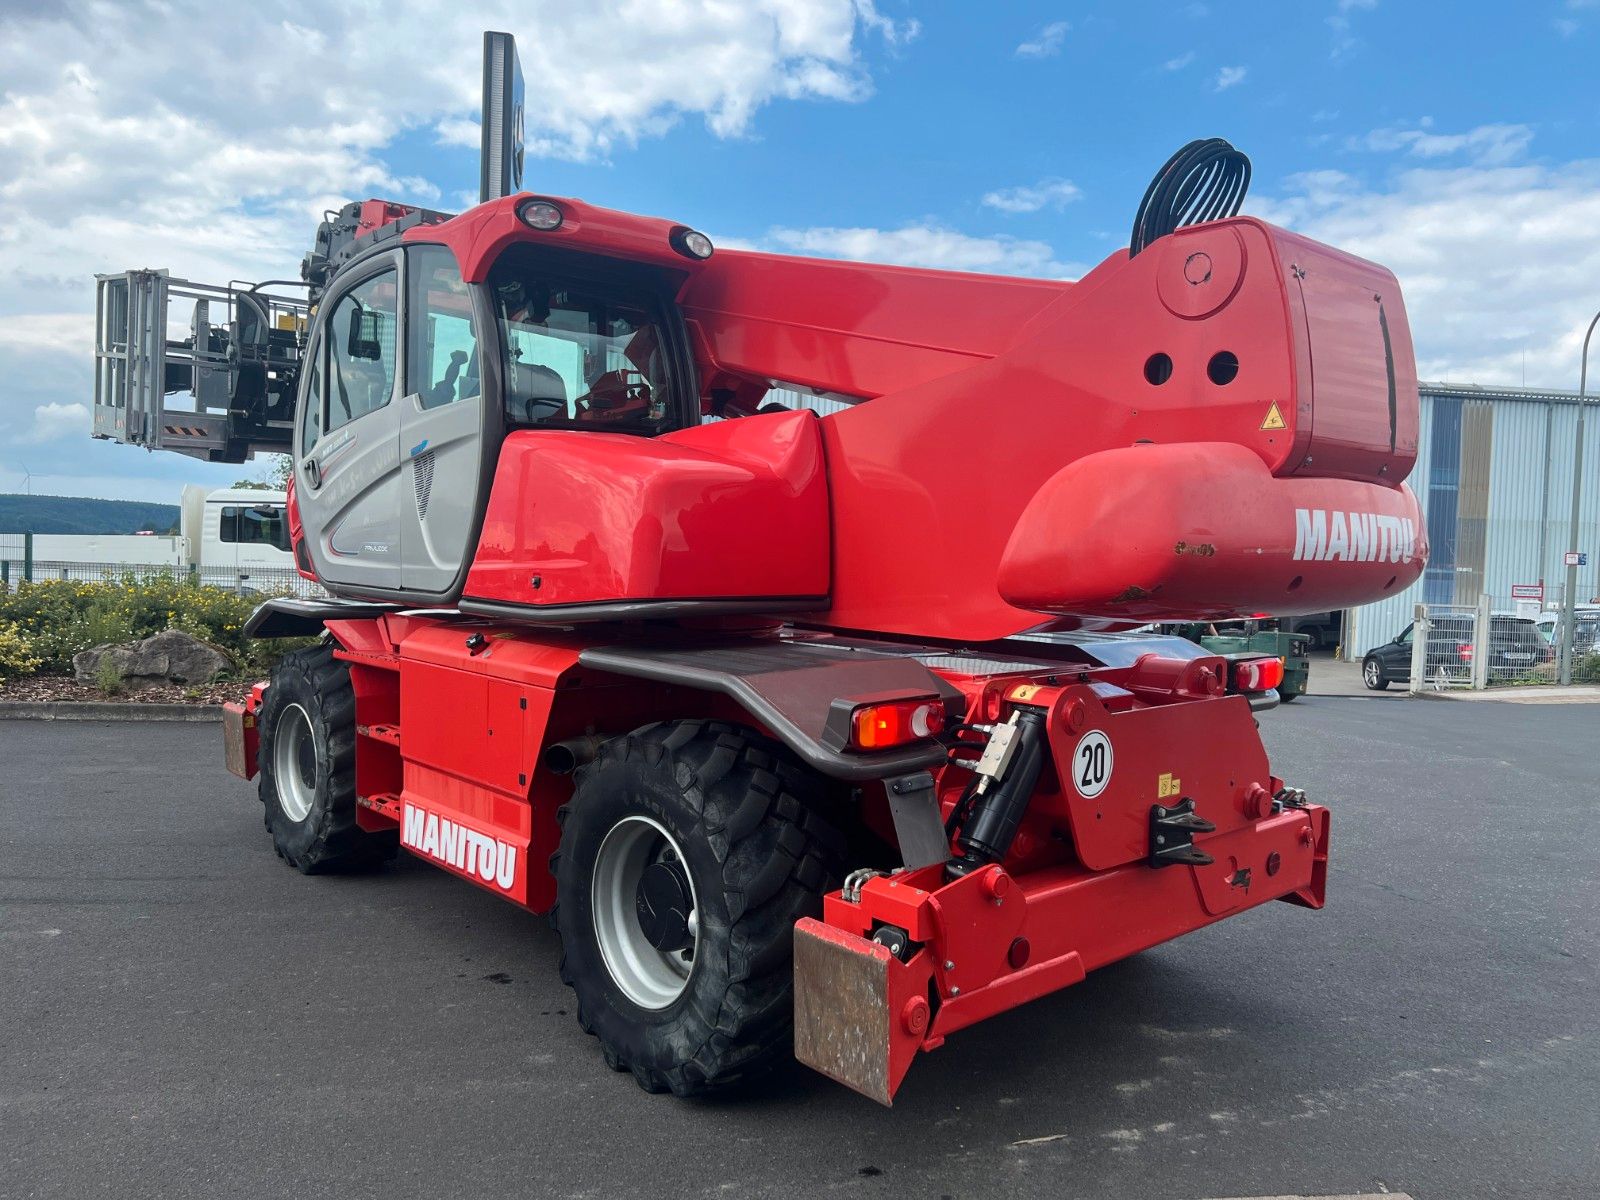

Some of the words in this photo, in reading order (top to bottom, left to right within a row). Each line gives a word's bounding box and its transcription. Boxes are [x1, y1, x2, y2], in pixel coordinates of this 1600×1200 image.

[1293, 509, 1416, 564] MANITOU
[1081, 743, 1105, 787] 20
[403, 804, 516, 889] MANITOU
